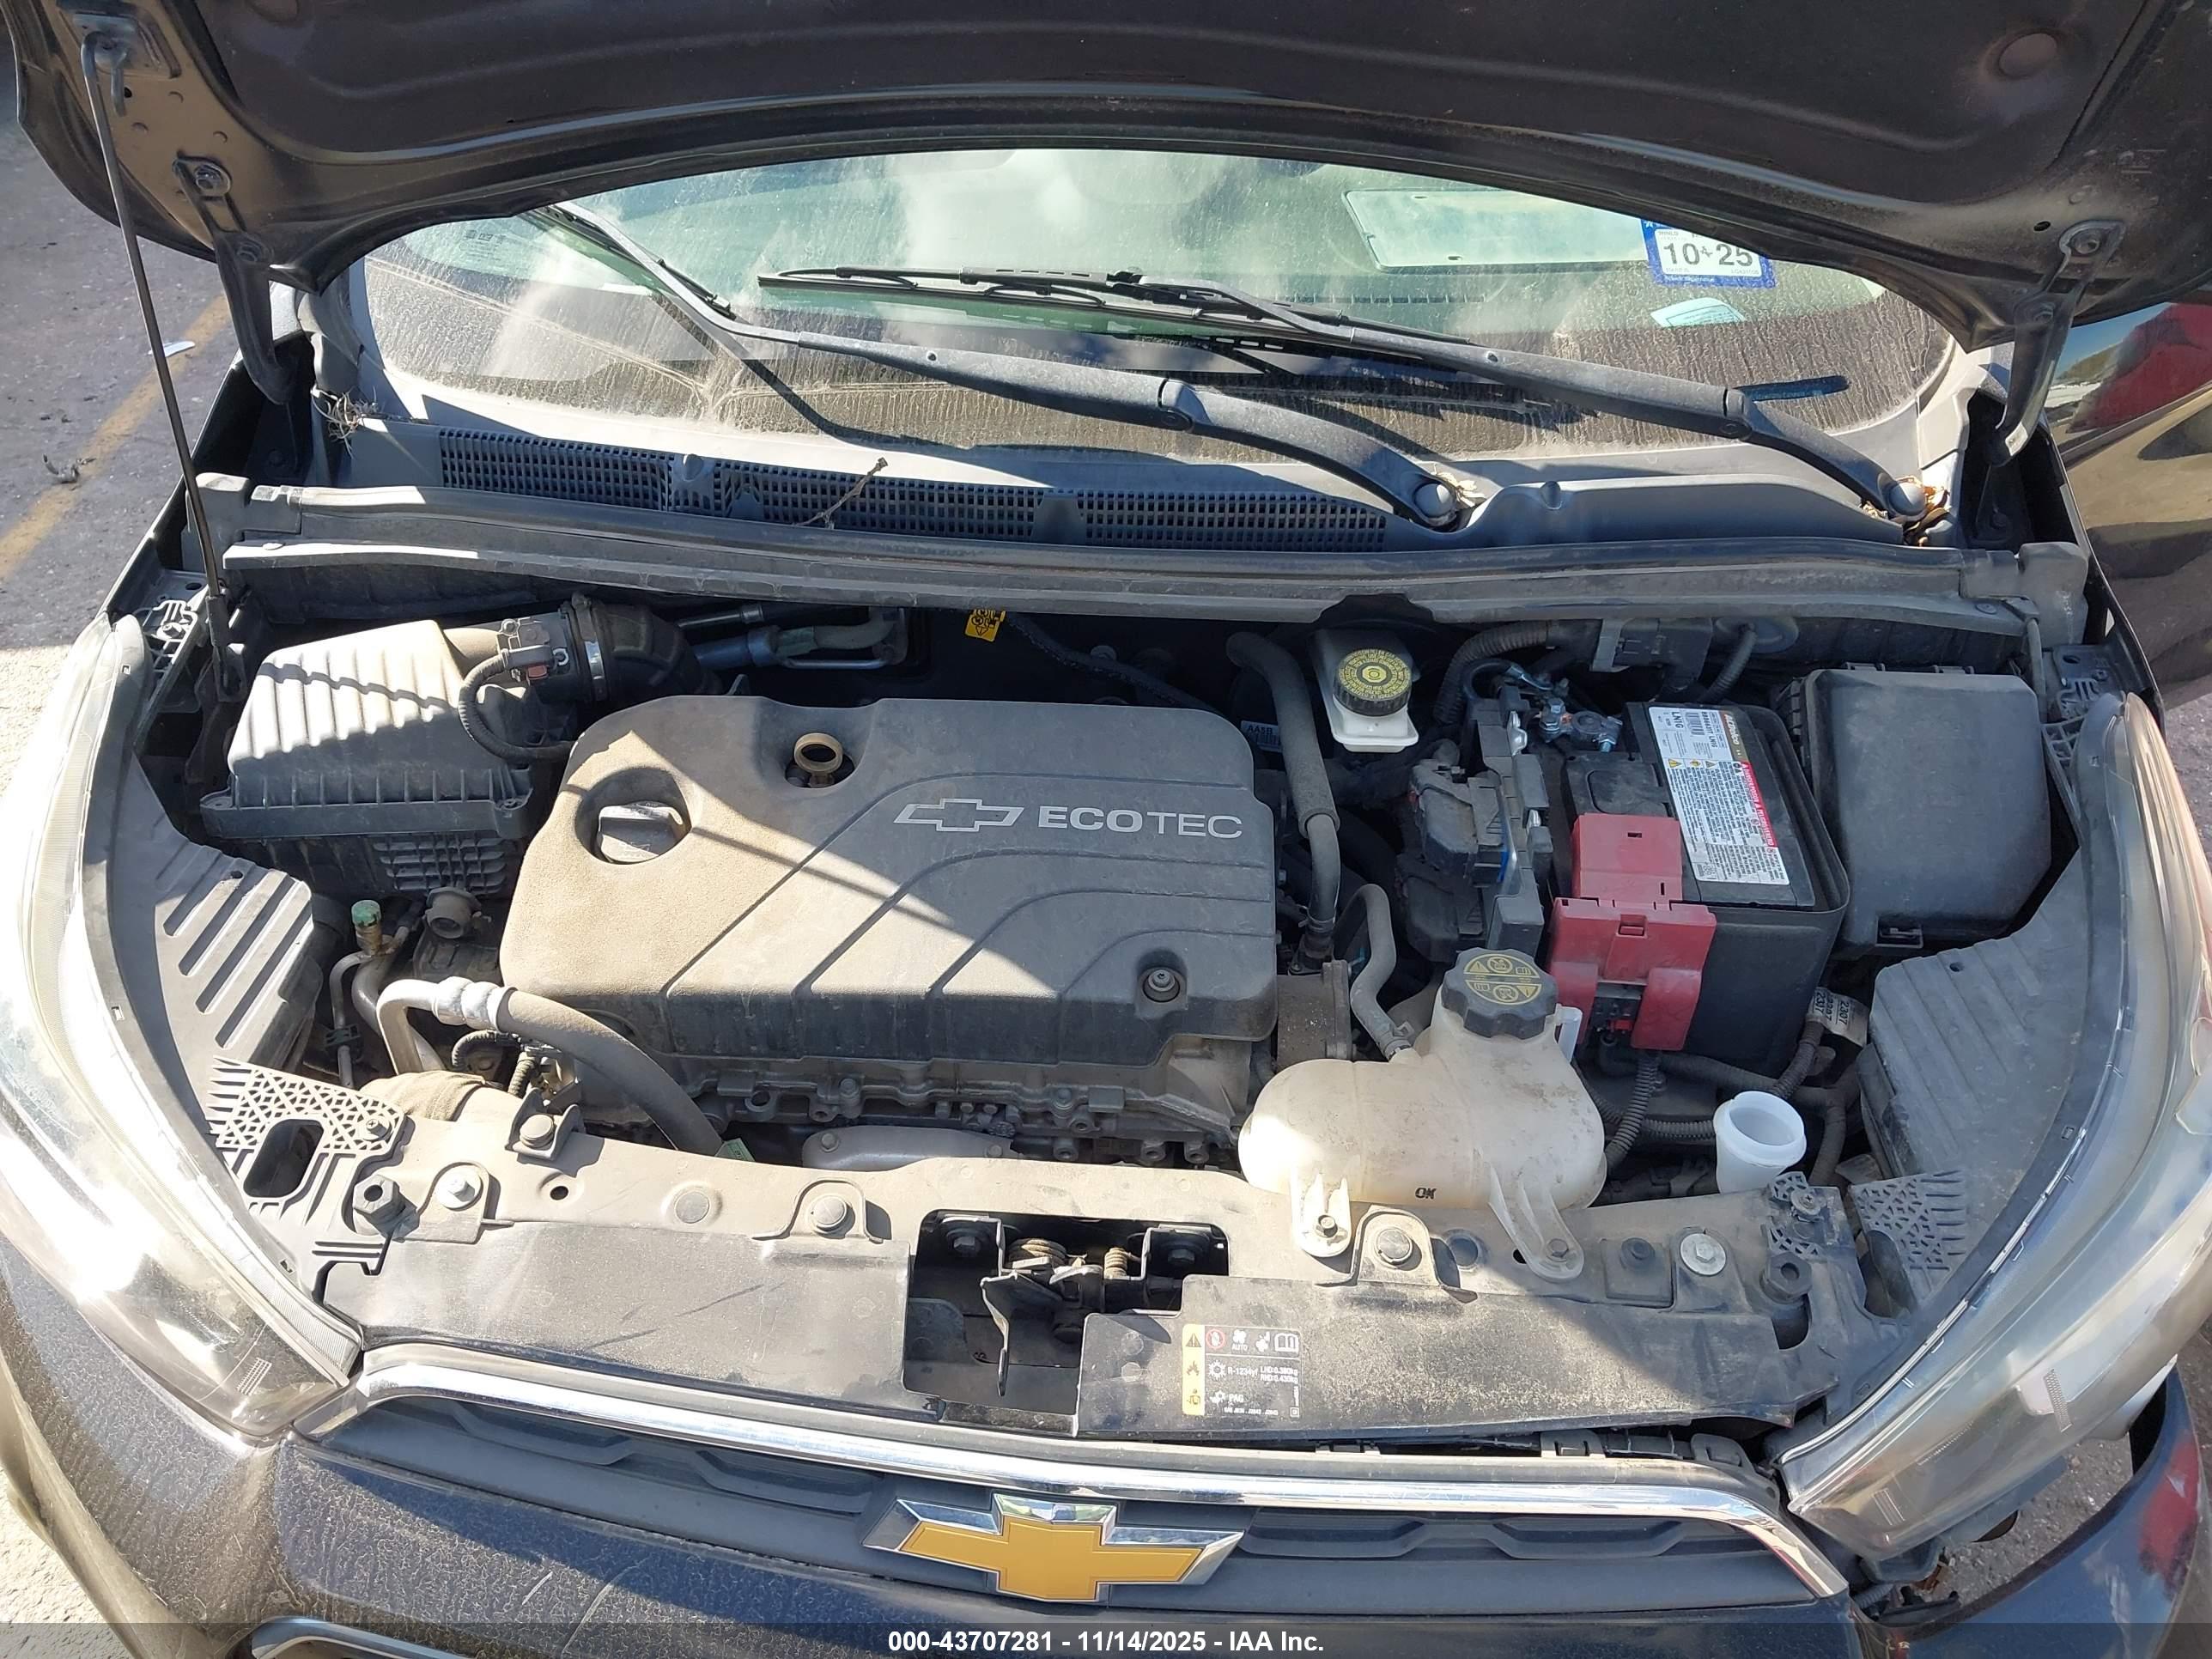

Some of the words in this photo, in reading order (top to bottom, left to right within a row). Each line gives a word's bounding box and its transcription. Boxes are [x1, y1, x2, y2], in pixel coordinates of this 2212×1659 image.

[1663, 242, 1700, 265] 10
[1716, 243, 1753, 267] 25
[1671, 711, 1684, 729] LN1G
[1037, 805, 1244, 840] ECOTEC
[1414, 1187, 1437, 1200] OK
[1231, 1343, 1249, 1352] AUTO
